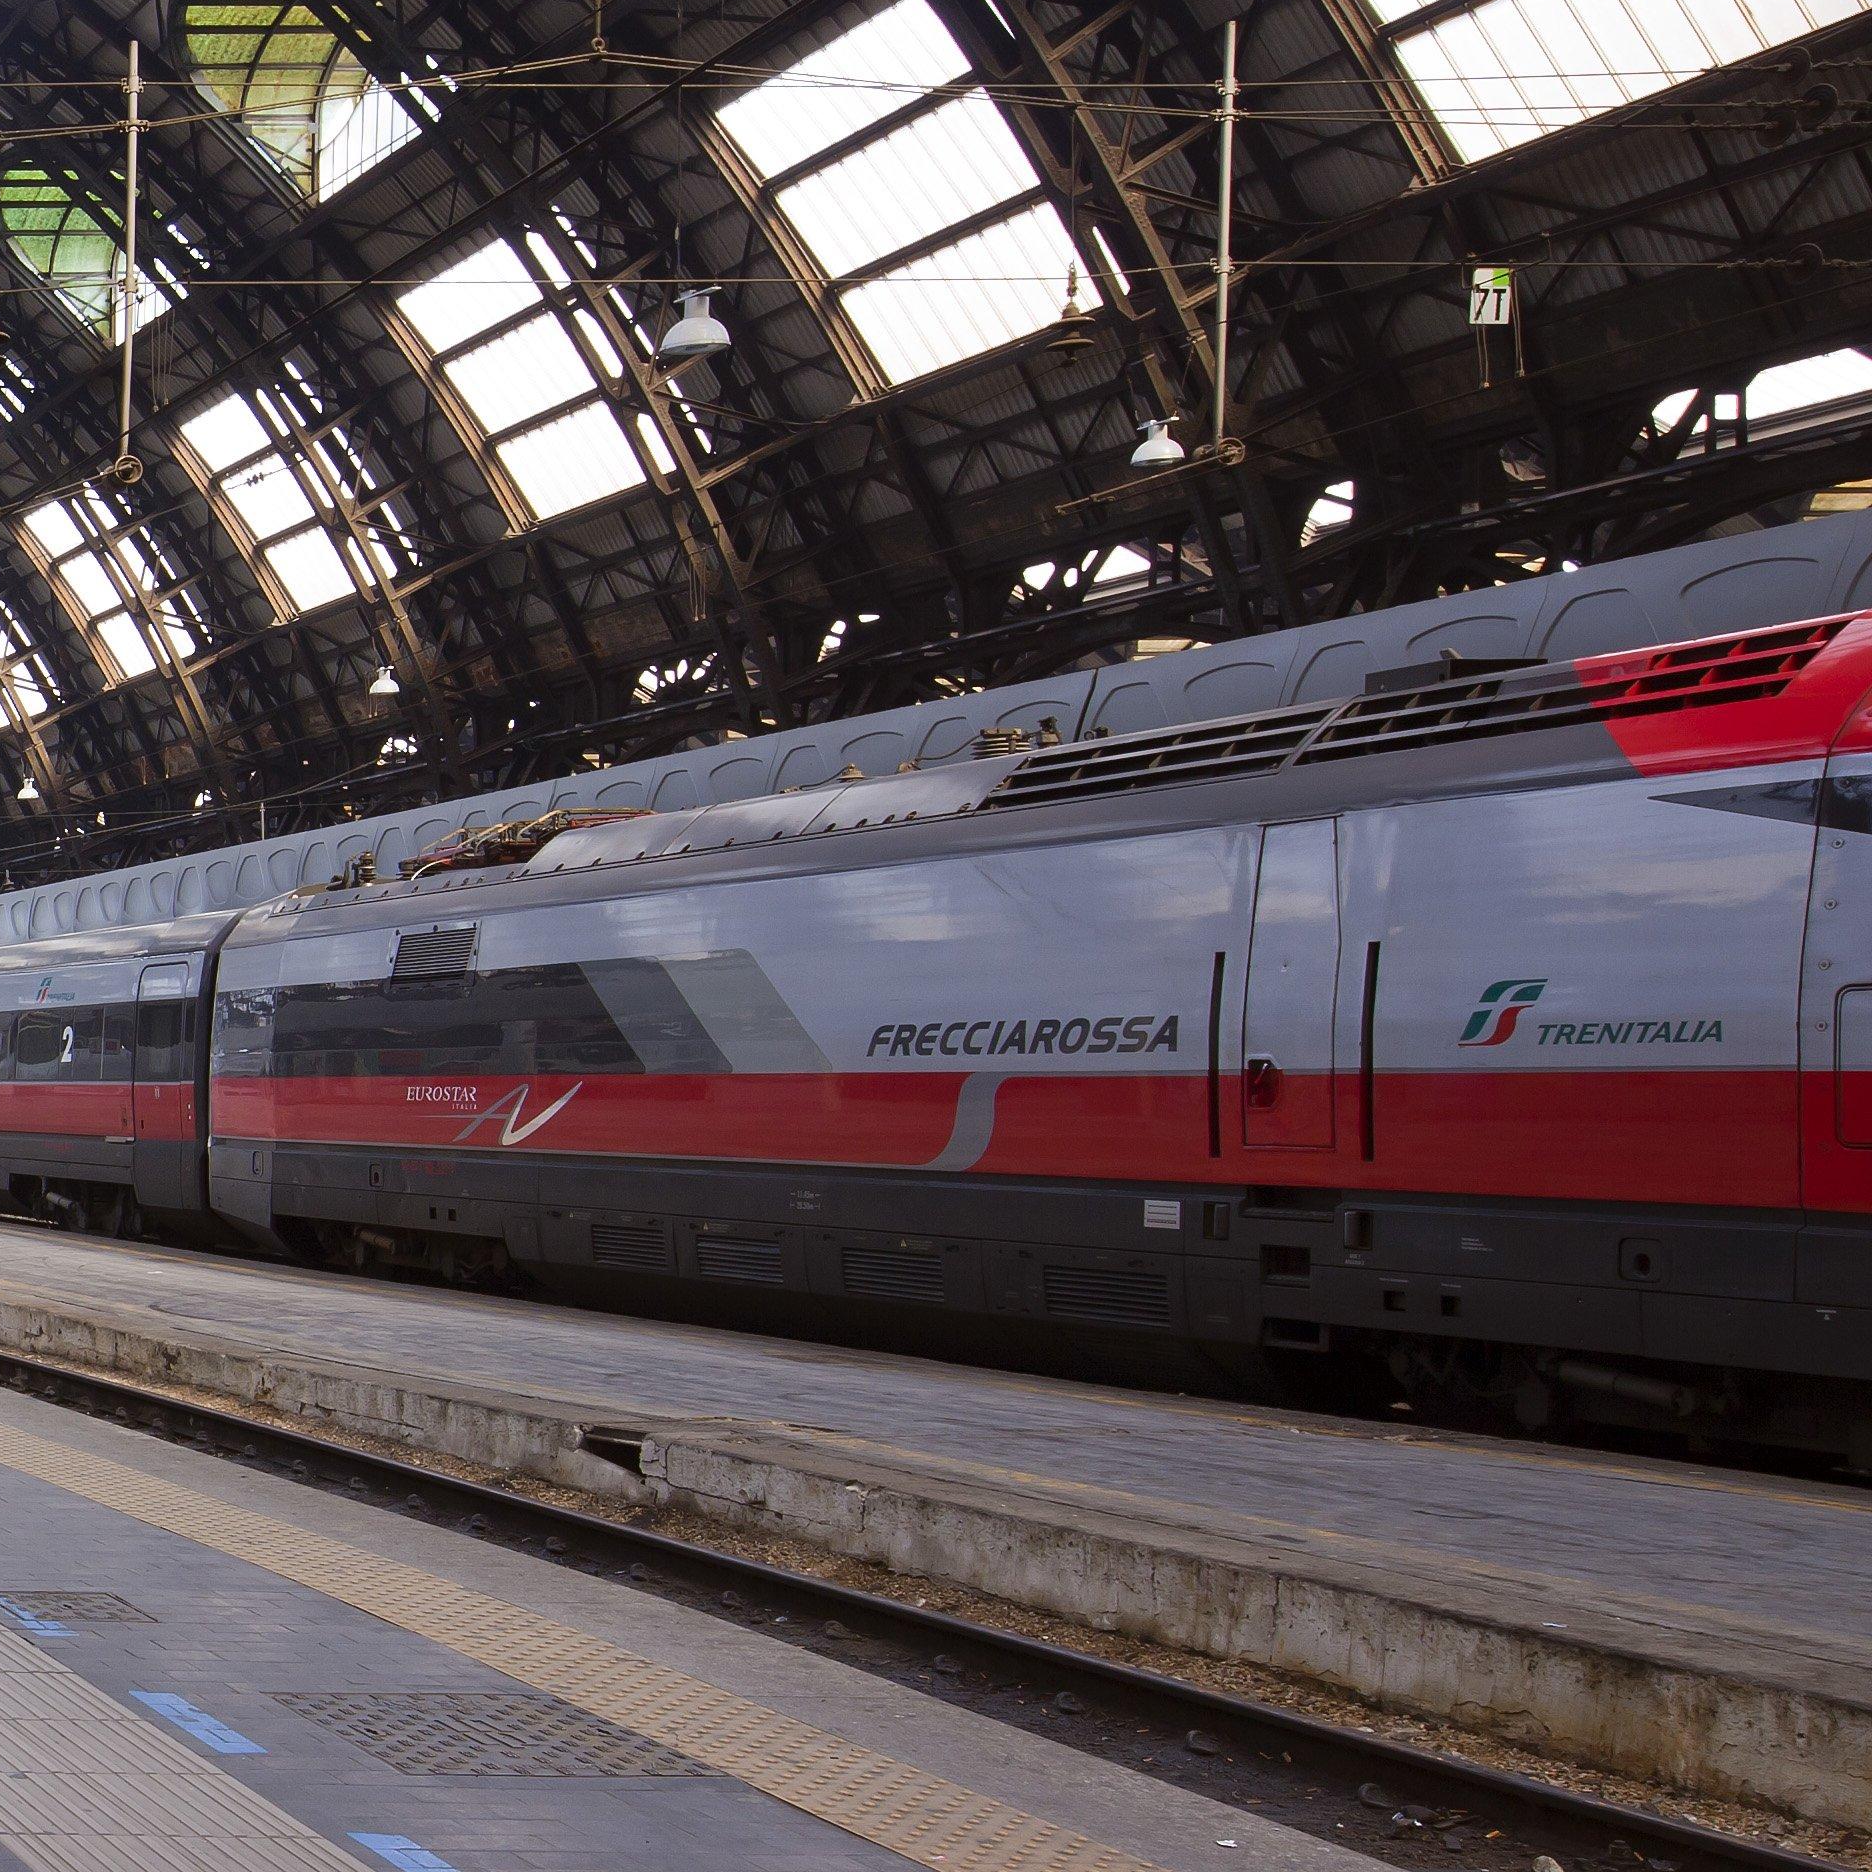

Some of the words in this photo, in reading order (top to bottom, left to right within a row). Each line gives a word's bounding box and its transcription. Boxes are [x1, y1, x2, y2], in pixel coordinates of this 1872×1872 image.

[1473, 288, 1507, 321] 7T
[60, 1025, 74, 1062] 2
[866, 1015, 1179, 1058] FRECCIAROSSA
[1538, 1020, 1722, 1046] TRENITALIA
[406, 1085, 477, 1102] EUROSTAR
